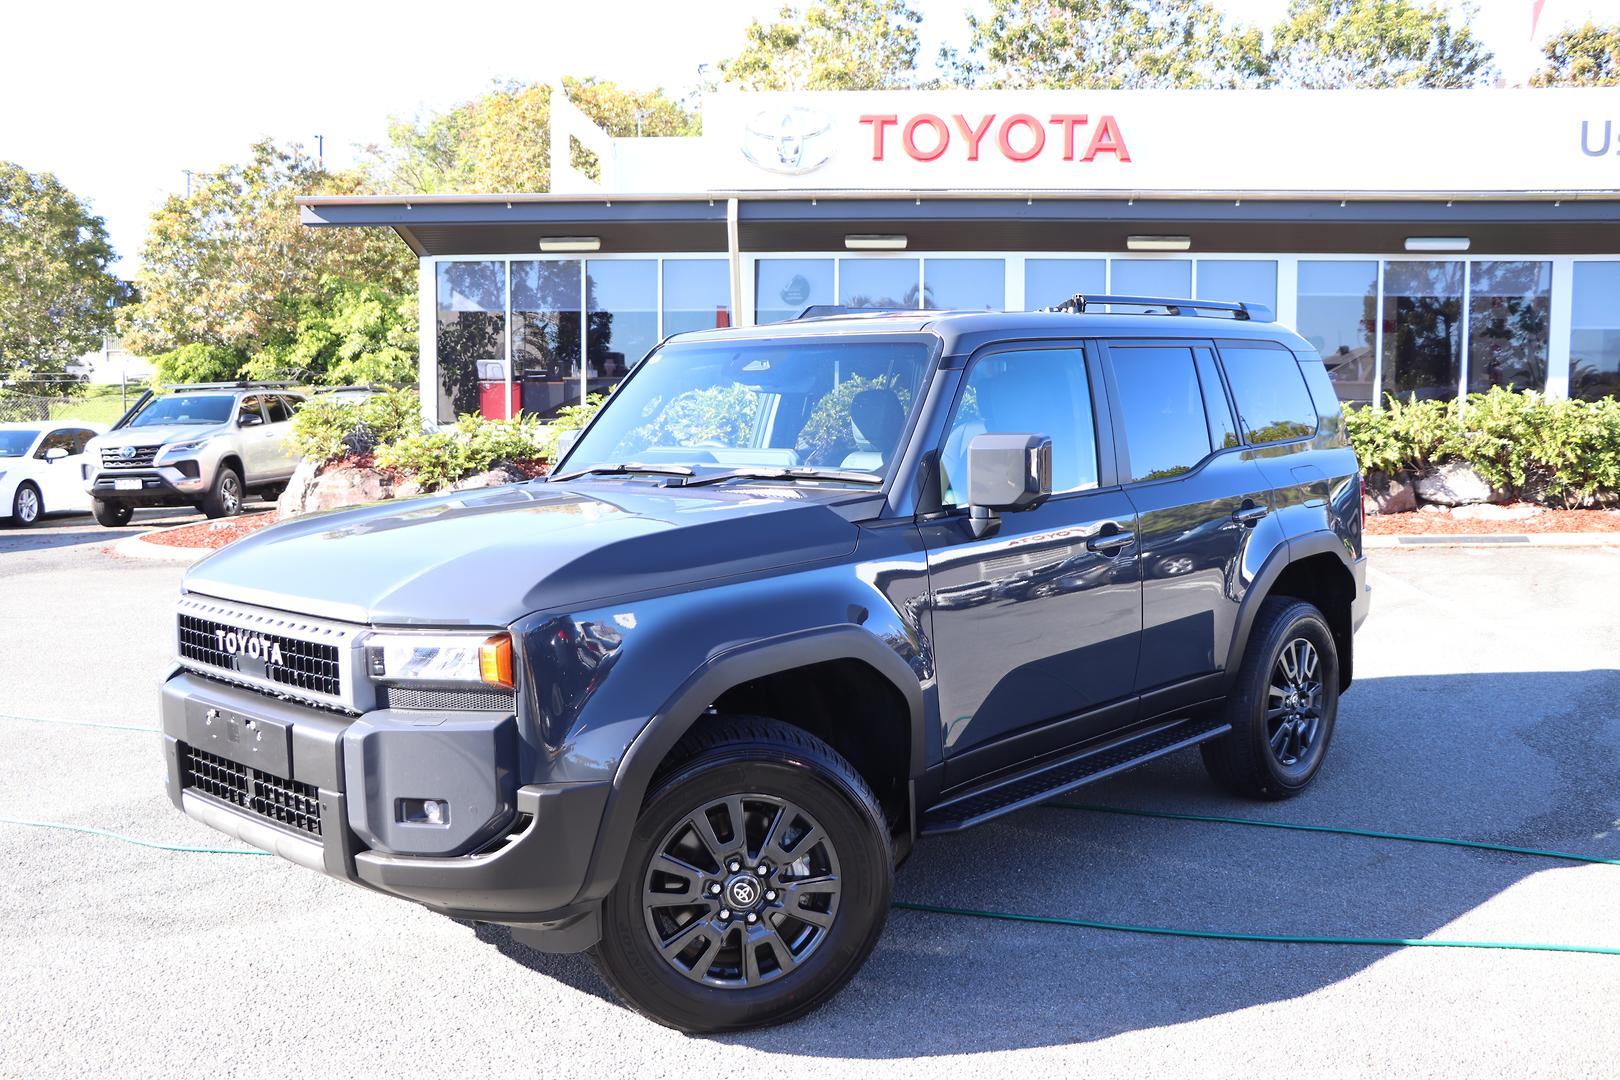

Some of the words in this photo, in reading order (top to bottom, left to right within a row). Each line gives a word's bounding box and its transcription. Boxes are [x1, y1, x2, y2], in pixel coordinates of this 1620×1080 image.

[859, 113, 1132, 163] TOYOTA
[1581, 120, 1620, 157] U
[215, 629, 283, 666] TOYOTA
